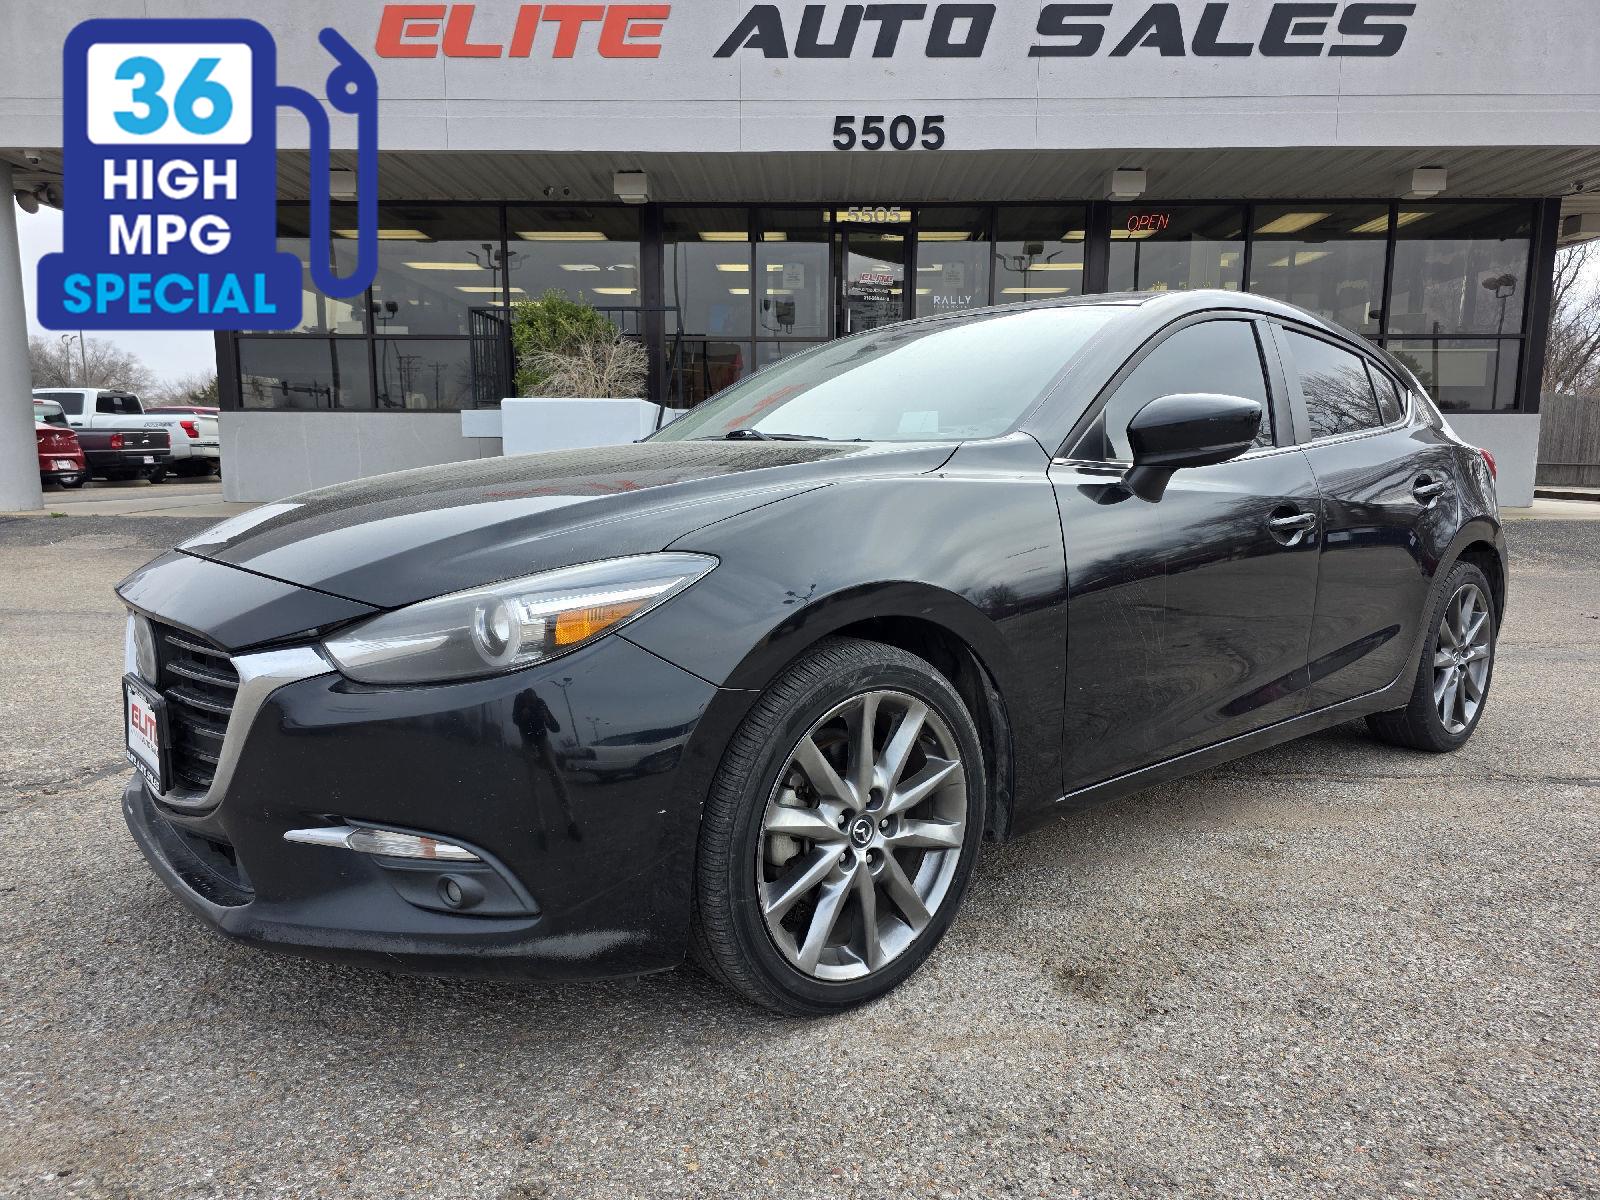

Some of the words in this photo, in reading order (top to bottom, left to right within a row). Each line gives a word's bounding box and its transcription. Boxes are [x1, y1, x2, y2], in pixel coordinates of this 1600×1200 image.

[376, 3, 671, 59] ELITE
[712, 3, 996, 59] AUTO
[1028, 2, 1416, 58] SALES
[833, 114, 946, 151] 5505
[848, 206, 901, 224] 5505
[1127, 213, 1170, 232] OPEN
[934, 296, 971, 304] RALLY
